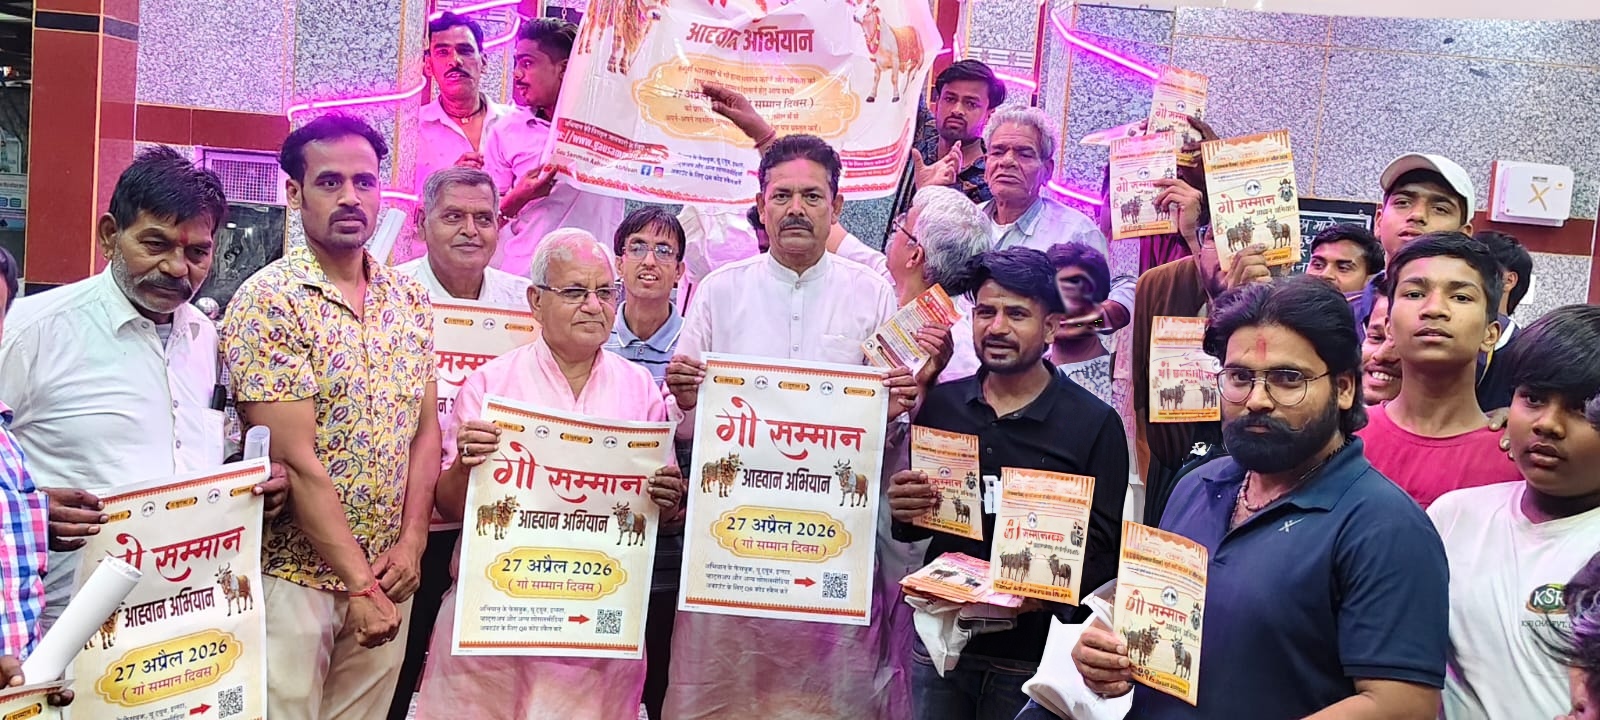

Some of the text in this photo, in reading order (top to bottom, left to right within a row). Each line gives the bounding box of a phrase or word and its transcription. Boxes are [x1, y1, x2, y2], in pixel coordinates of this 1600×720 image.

[743, 25, 815, 53] अभियान
[1236, 194, 1277, 214] सम्मान
[764, 419, 867, 461] सम्मान
[544, 465, 648, 504] सम्मान
[785, 467, 832, 495] अभियान
[562, 509, 610, 534] अभियान
[726, 514, 837, 538] 27 अप्रैल 2026
[150, 525, 246, 582] सम्मान
[756, 540, 788, 553] सम्मान
[791, 540, 820, 555] दिवस
[501, 554, 613, 577] 27 अप्रैल 2026
[531, 581, 563, 592] सम्मान
[566, 579, 595, 593] दिवस
[169, 586, 215, 618] अभियान
[1147, 601, 1188, 626] सम्मान
[114, 639, 228, 683] 27 अप्रैल 2026
[148, 674, 182, 693] सम्मान
[184, 666, 212, 683] दिवस
